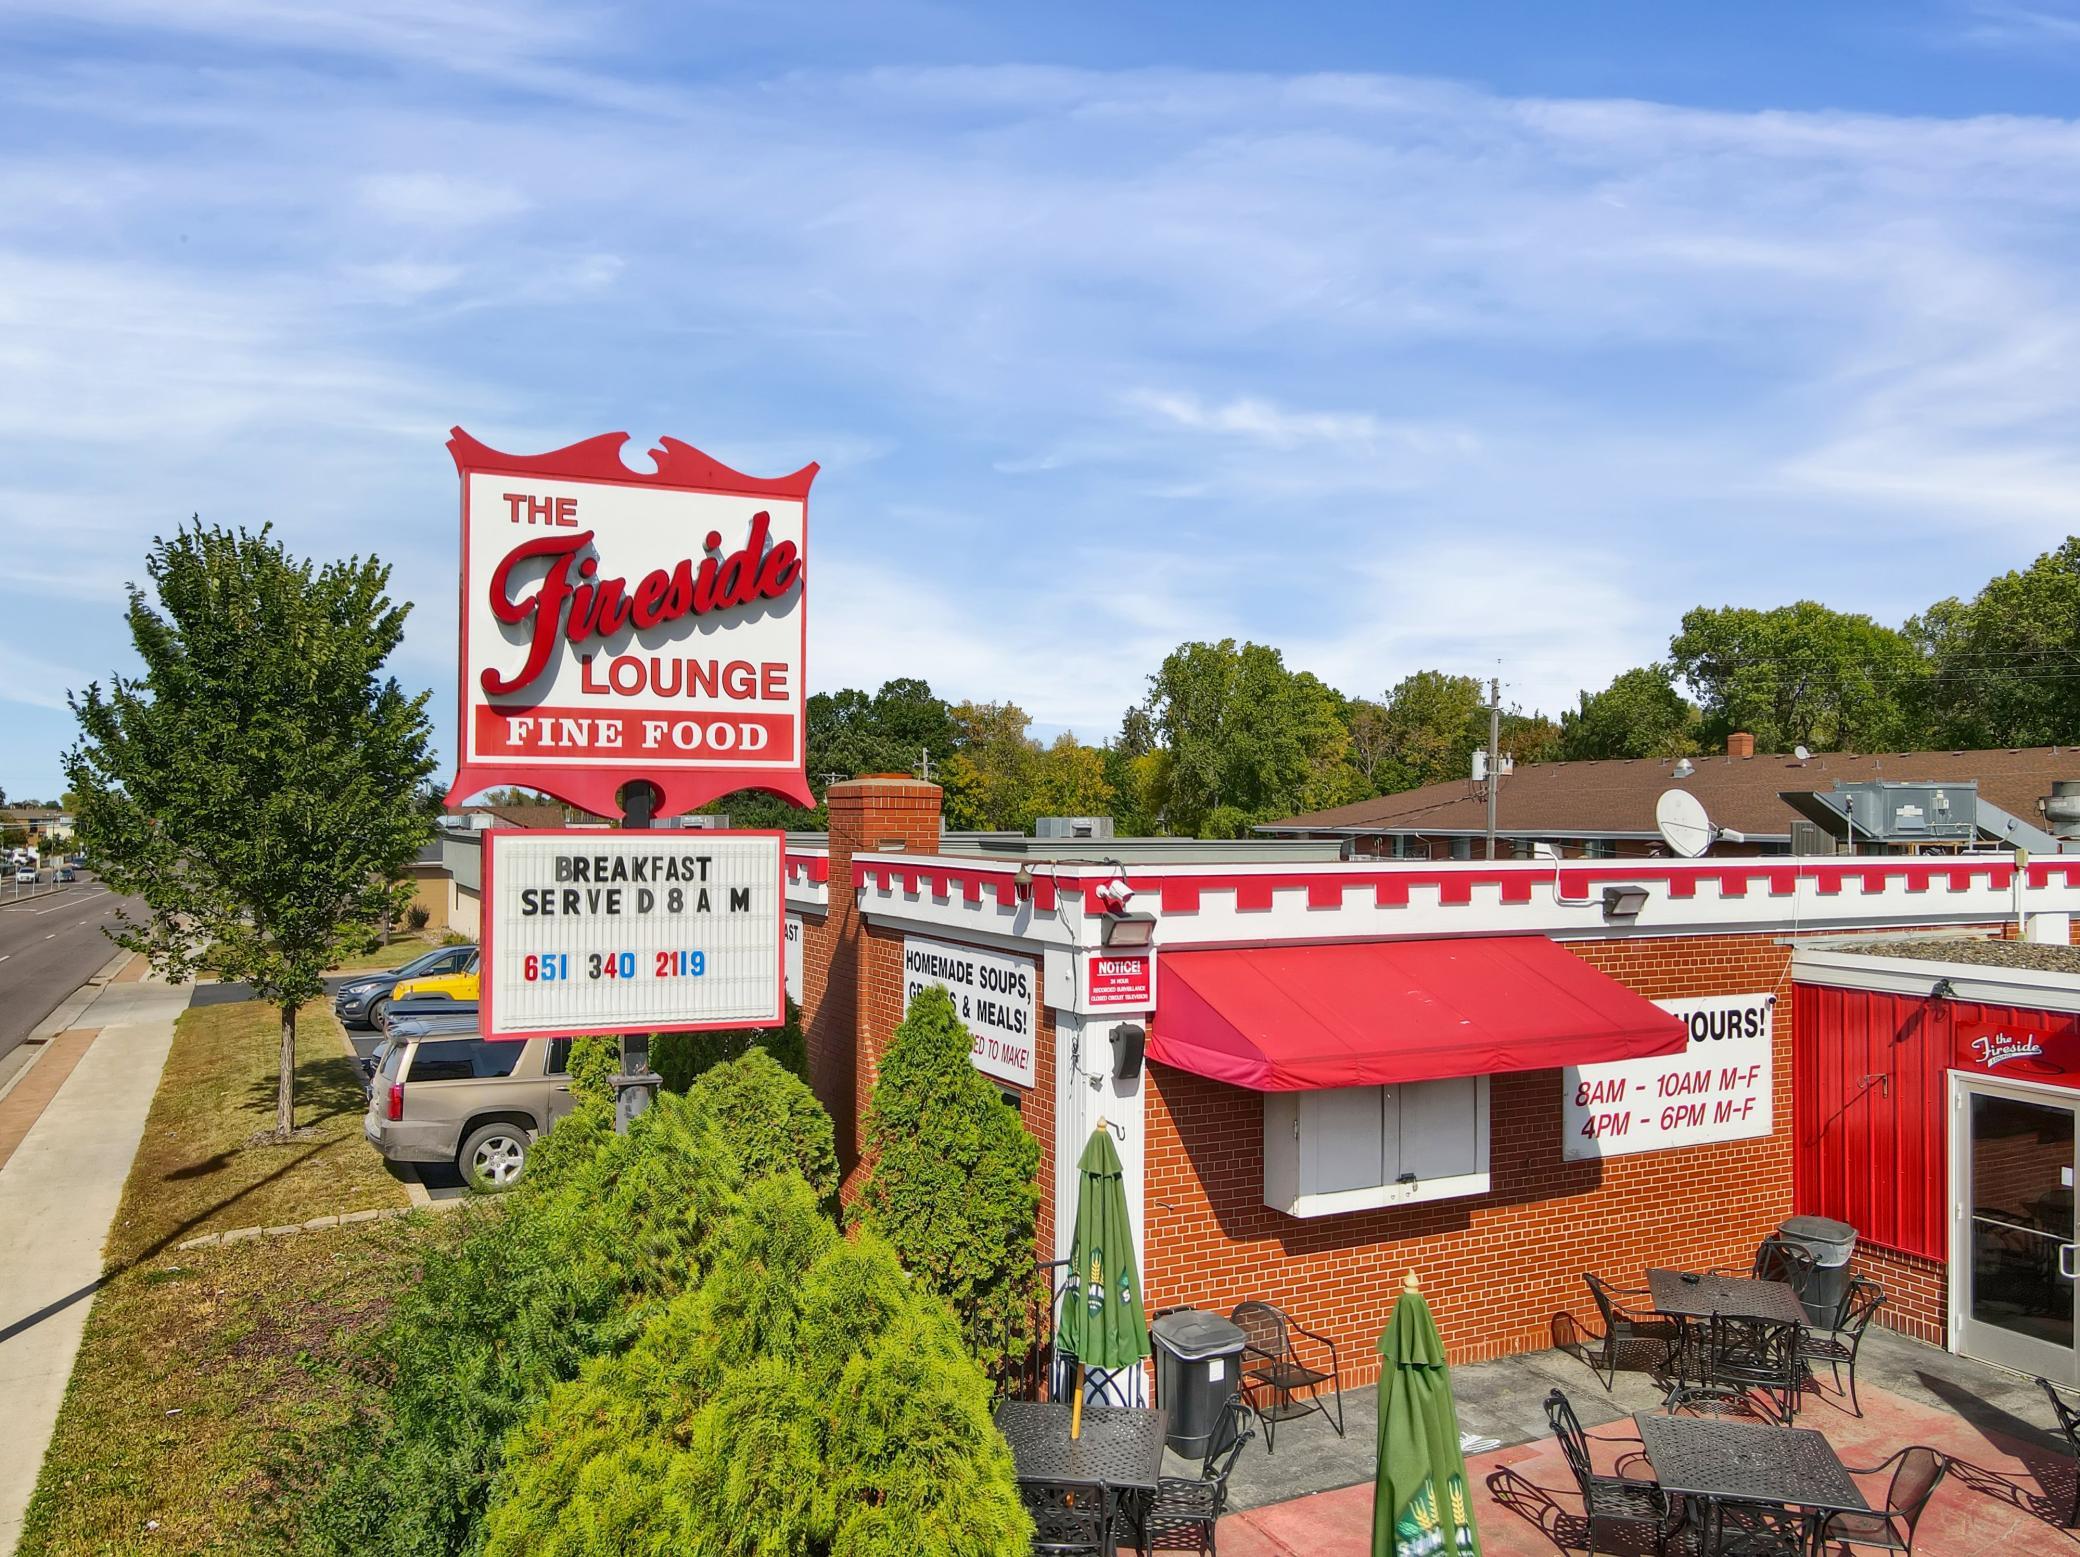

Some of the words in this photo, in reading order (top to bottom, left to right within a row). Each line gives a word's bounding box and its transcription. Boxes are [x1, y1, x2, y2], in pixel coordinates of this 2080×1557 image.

[503, 493, 578, 527] THE
[480, 511, 804, 697] Fireside
[581, 654, 790, 700] LOUNGE
[505, 717, 623, 748] FINE
[641, 720, 768, 751] FOOD
[555, 855, 711, 883] BREAKFAST
[524, 953, 567, 981] 651
[589, 952, 636, 979] 340
[656, 950, 705, 977] 2119
[906, 949, 974, 986] HOMEMADE
[980, 965, 1031, 1005] SOUPS,
[1098, 960, 1141, 974] NOTICE!
[962, 995, 971, 1019] &
[977, 999, 1027, 1035] MEALS!
[988, 1038, 999, 1060] TO
[1001, 1043, 1030, 1070] MAKE!
[1971, 1033, 2042, 1063] Fireside
[1996, 1032, 2012, 1045] the
[1575, 1078, 1626, 1107] 8AM
[1657, 1069, 1711, 1097] 10AM
[1718, 1065, 1761, 1091] M-F
[1581, 1111, 1631, 1139] 4PM
[1660, 1103, 1707, 1130] 6PM
[1713, 1097, 1756, 1124] M-F
